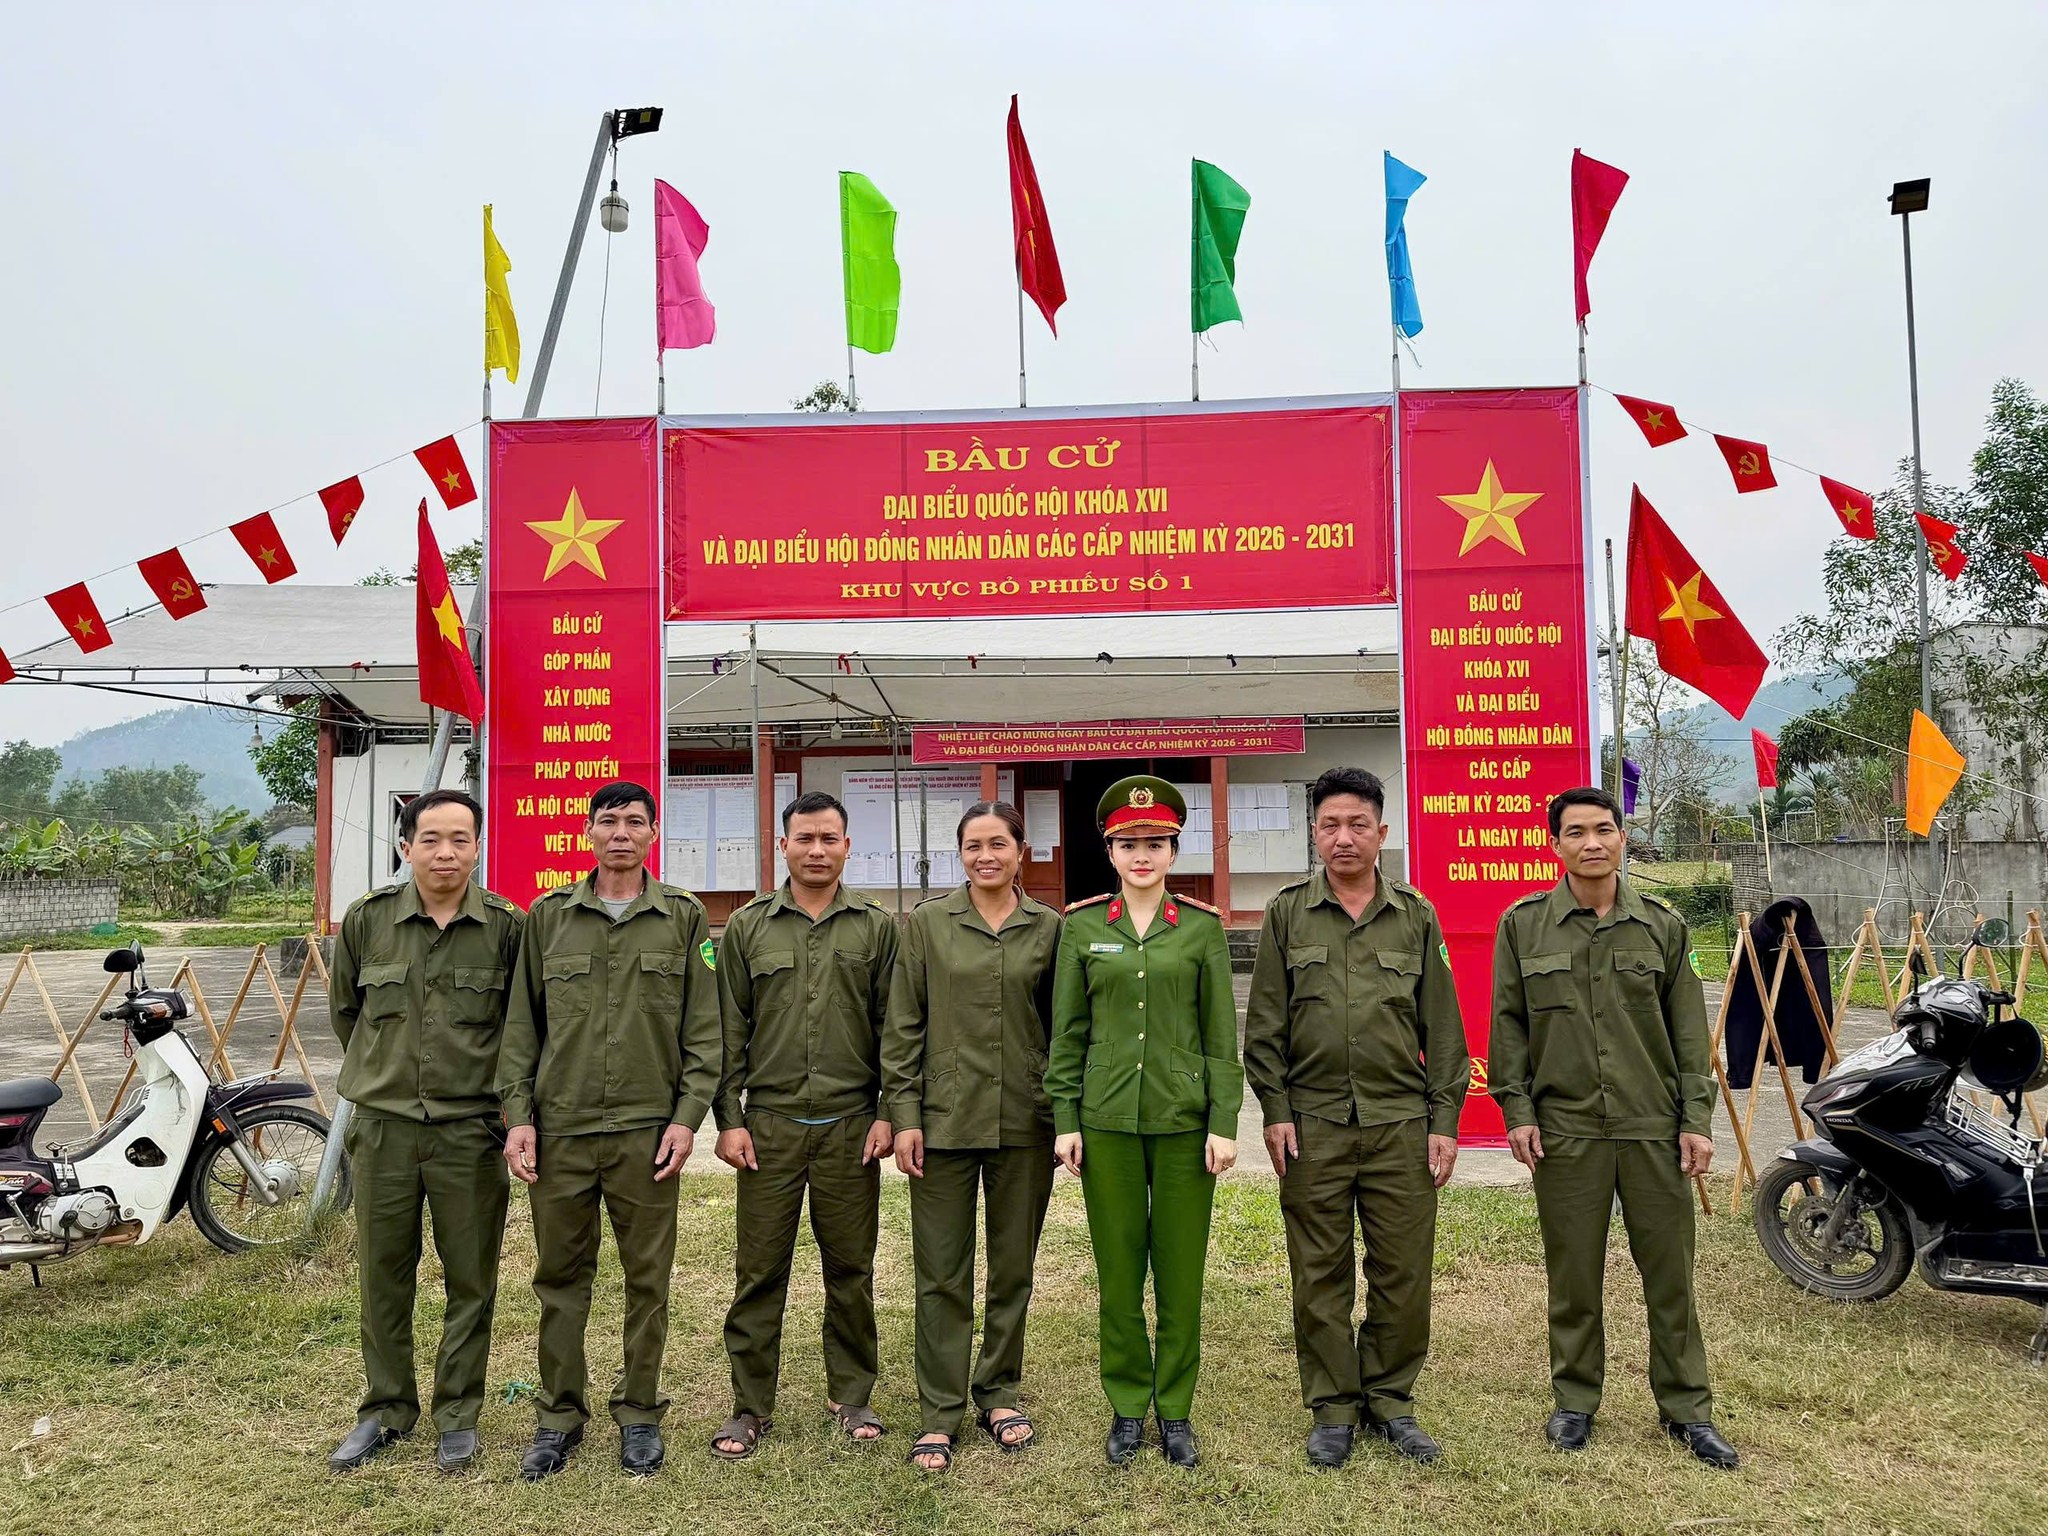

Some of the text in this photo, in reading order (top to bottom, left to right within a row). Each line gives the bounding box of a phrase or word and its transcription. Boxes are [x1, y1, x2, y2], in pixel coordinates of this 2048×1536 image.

[924, 434, 1121, 472] BẦU CỬ
[883, 483, 1167, 524] ĐẠI BIỂU QUỐC HỘI KHÓA XVI
[703, 536, 729, 564] VÀ
[734, 540, 767, 568] ĐẠI
[774, 527, 819, 563] BIỂU
[826, 531, 858, 567] HỘI
[864, 530, 919, 562] ĐỒNG
[926, 531, 982, 560] NHÂN
[988, 529, 1029, 560] DÂN
[1036, 529, 1076, 559] CÁC
[1083, 525, 1123, 557] CẤP
[1129, 525, 1196, 559] NHIỆM
[1203, 523, 1228, 553] KỲ
[1235, 526, 1285, 551] 2026
[1306, 523, 1353, 549] 2031
[841, 570, 1191, 600] KHU VỰC BỎ PHIẾU SỐ 1
[1469, 589, 1522, 612] BẦU CỬ
[553, 610, 602, 634] BẦU CỬ
[1431, 620, 1561, 648] ĐẠI BIỂU QUỐC HỘI
[544, 646, 611, 670] GÓP PHẦN
[1464, 657, 1529, 678] KHÓA XVI
[545, 686, 610, 708] XÂY DỰNG
[1456, 685, 1539, 713] VÀ ĐẠI BIỂU
[543, 721, 611, 742] NHÀ NƯỚC
[1427, 723, 1572, 748] HỘI ĐỒNG NHÂN DÂN
[943, 745, 957, 755] VÀ
[959, 746, 976, 756] ĐẠI
[1004, 744, 1022, 755] HỘI
[1057, 742, 1086, 752] NHÂN
[1088, 741, 1111, 751] DÂN
[1112, 740, 1133, 750] CÁC
[1159, 739, 1192, 750] NHIỆM
[1211, 739, 1236, 747] 2026
[535, 757, 619, 780] PHÁP QUYỀN
[1469, 757, 1531, 779] CÁC CẤP
[517, 795, 534, 816] XÃ
[538, 794, 560, 818] HỘI
[1423, 792, 1469, 816] NHIỆM
[1474, 790, 1492, 812] KỲ
[1497, 795, 1531, 813] 2026
[545, 830, 594, 855] VIỆT NA
[1459, 824, 1546, 849] LÀ NGÀY HỘI
[536, 867, 572, 890] VỮNG
[1449, 858, 1560, 881] CỦA TOÀN DÂN!
